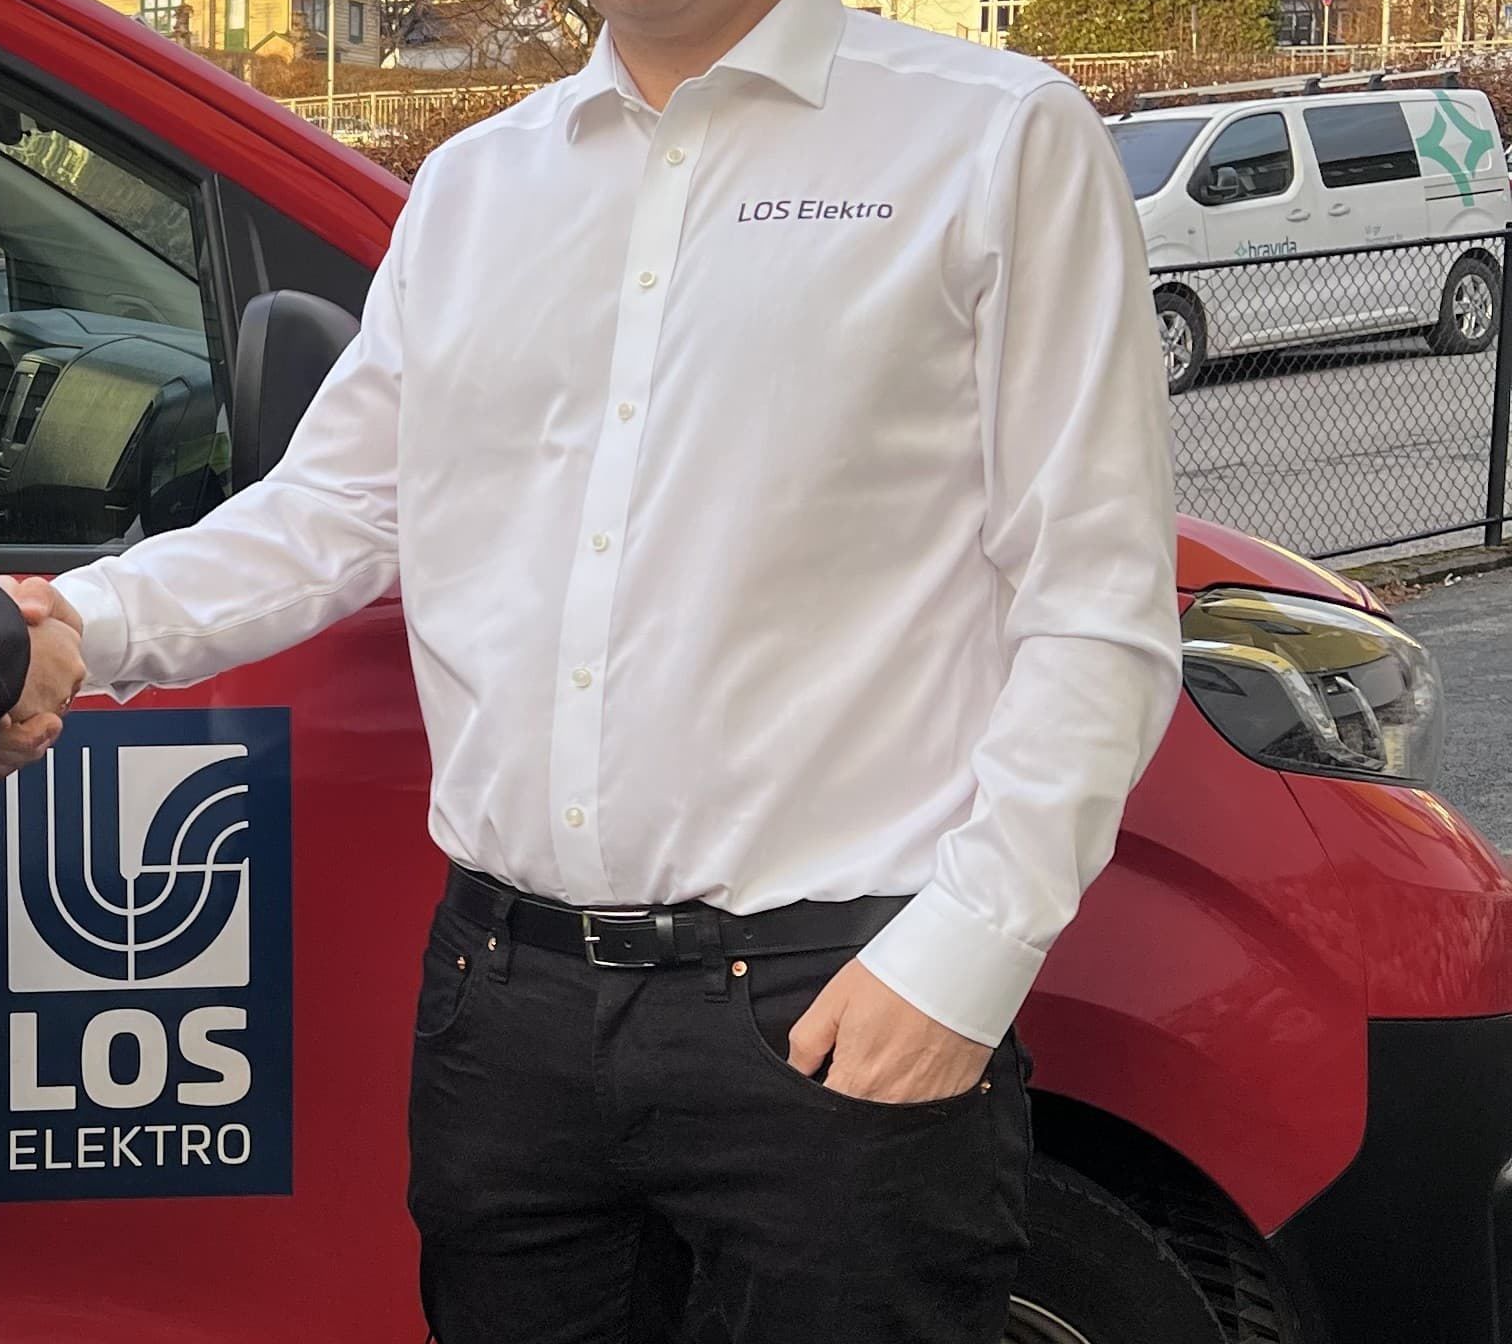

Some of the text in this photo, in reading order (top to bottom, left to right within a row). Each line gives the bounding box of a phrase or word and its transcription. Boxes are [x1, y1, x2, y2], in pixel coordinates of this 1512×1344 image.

[738, 200, 893, 222] LOS Elektro
[9, 1006, 252, 1112] LOS
[9, 1123, 251, 1171] ELEKTRO
